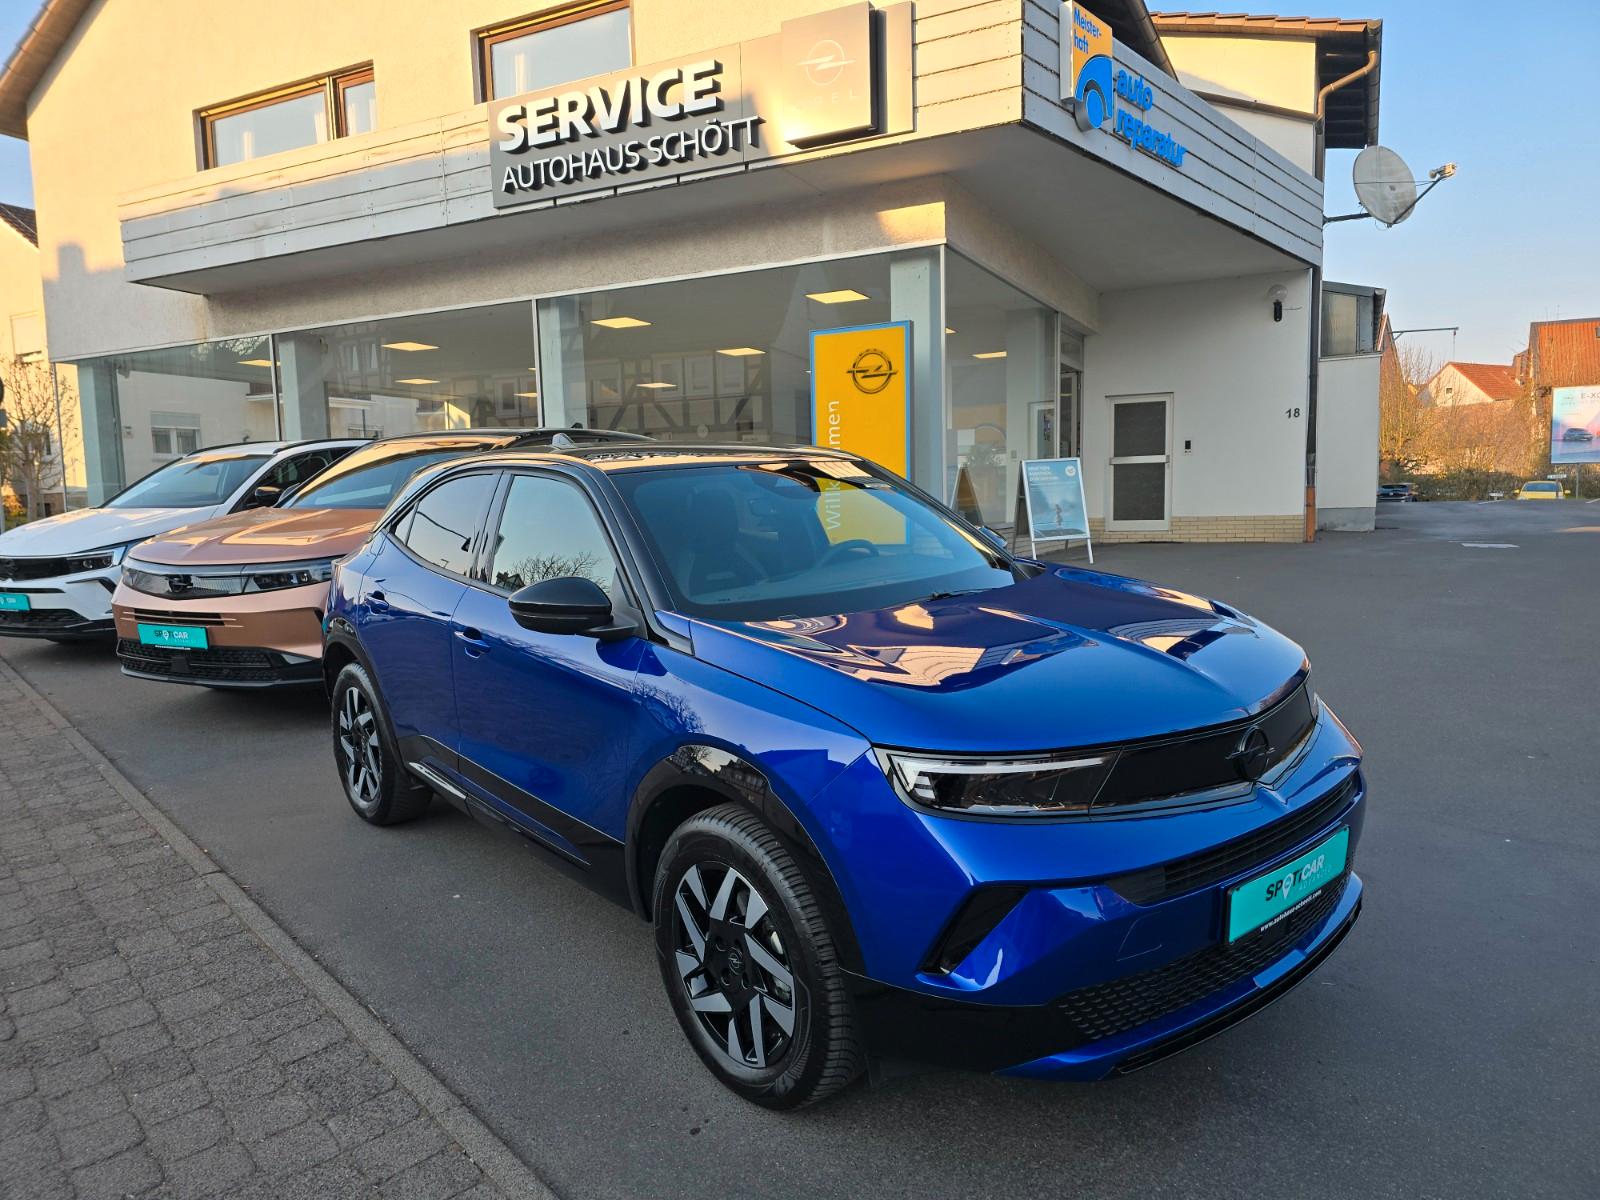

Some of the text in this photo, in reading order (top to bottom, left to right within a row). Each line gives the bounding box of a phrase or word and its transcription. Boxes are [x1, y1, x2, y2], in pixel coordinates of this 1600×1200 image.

[1074, 7, 1102, 39] Meister-
[1074, 29, 1089, 54] haft
[497, 59, 720, 152] SERVICE
[1116, 69, 1153, 111] auto
[501, 115, 760, 192] AUTOHAUS SCHÖTT
[1117, 108, 1188, 167] reparatur
[1285, 407, 1300, 419] 18
[825, 400, 841, 530] Willkmen
